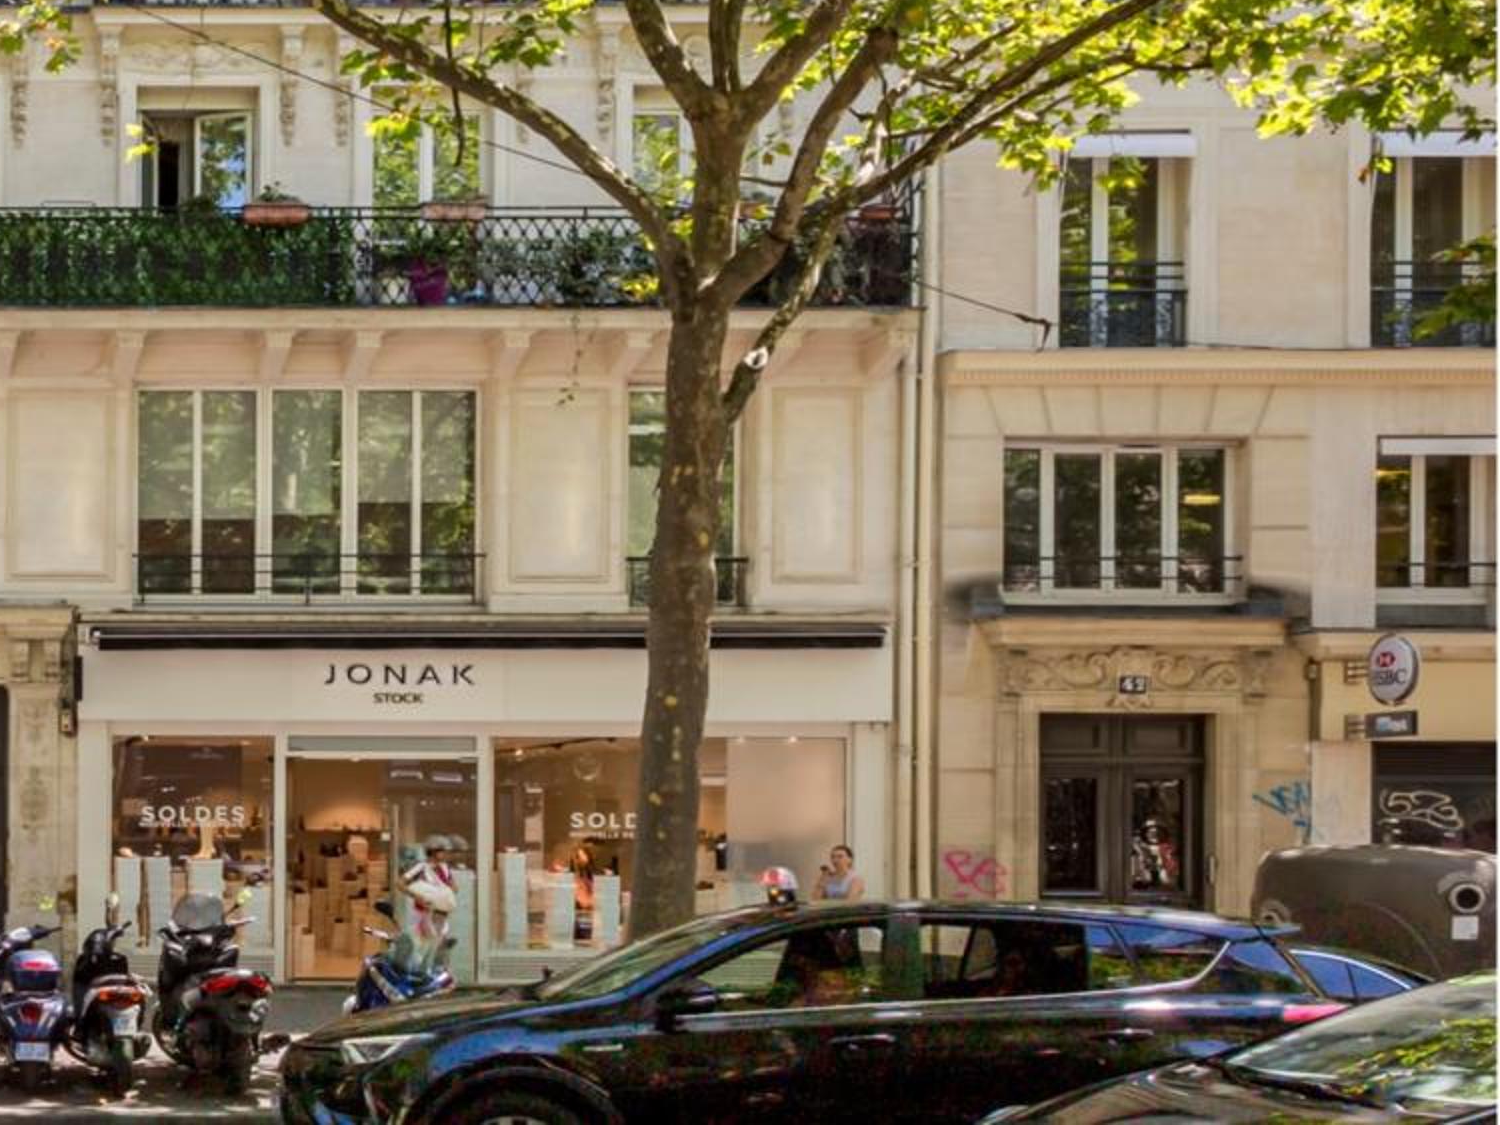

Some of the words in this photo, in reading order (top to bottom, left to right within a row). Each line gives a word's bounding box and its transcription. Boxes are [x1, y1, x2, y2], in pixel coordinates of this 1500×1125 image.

[324, 663, 475, 685] JONAK
[373, 692, 423, 704] STOCK
[141, 805, 245, 822] SOLDES
